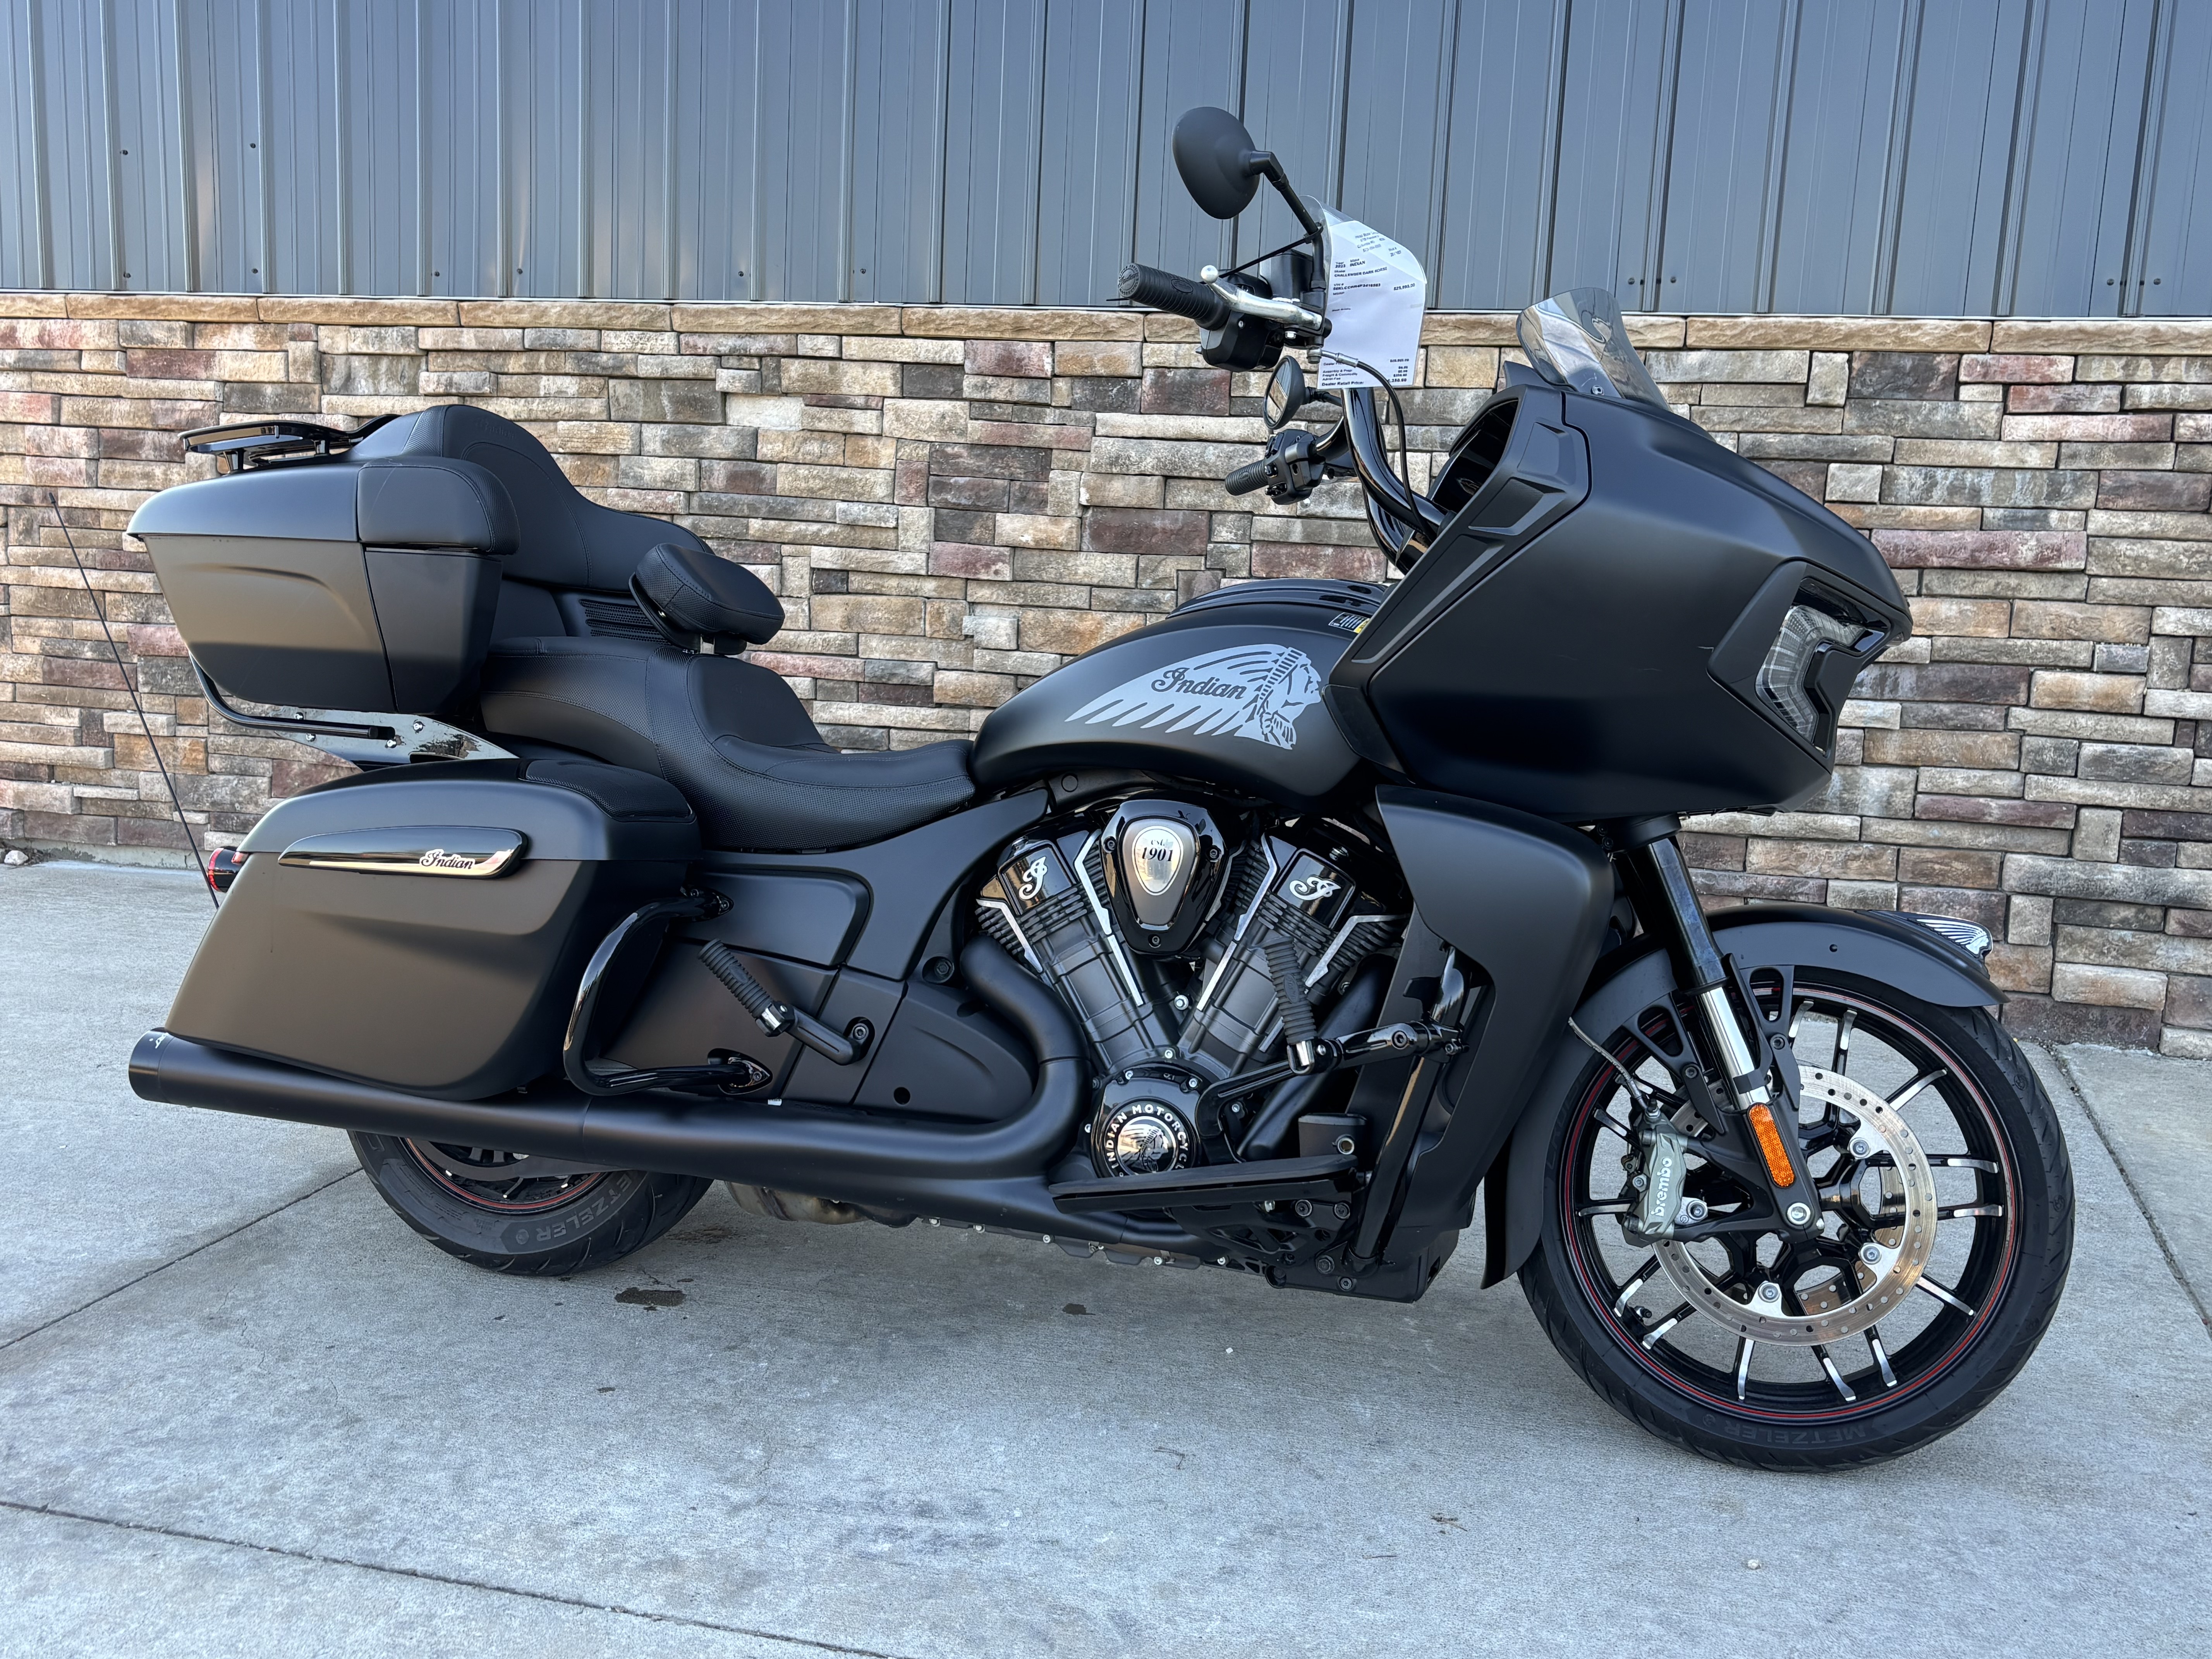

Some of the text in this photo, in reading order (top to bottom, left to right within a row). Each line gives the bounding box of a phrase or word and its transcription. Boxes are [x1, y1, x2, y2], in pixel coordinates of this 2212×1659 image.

[1151, 667, 1247, 700] Indian
[421, 850, 474, 870] Indian
[1142, 847, 1173, 862] 1901
[1106, 1104, 1188, 1169] INDIAN MOTORCYCL
[1650, 1157, 1673, 1217] brembo
[536, 1173, 632, 1242] ETZELER
[1724, 1420, 1867, 1444] METZELER
